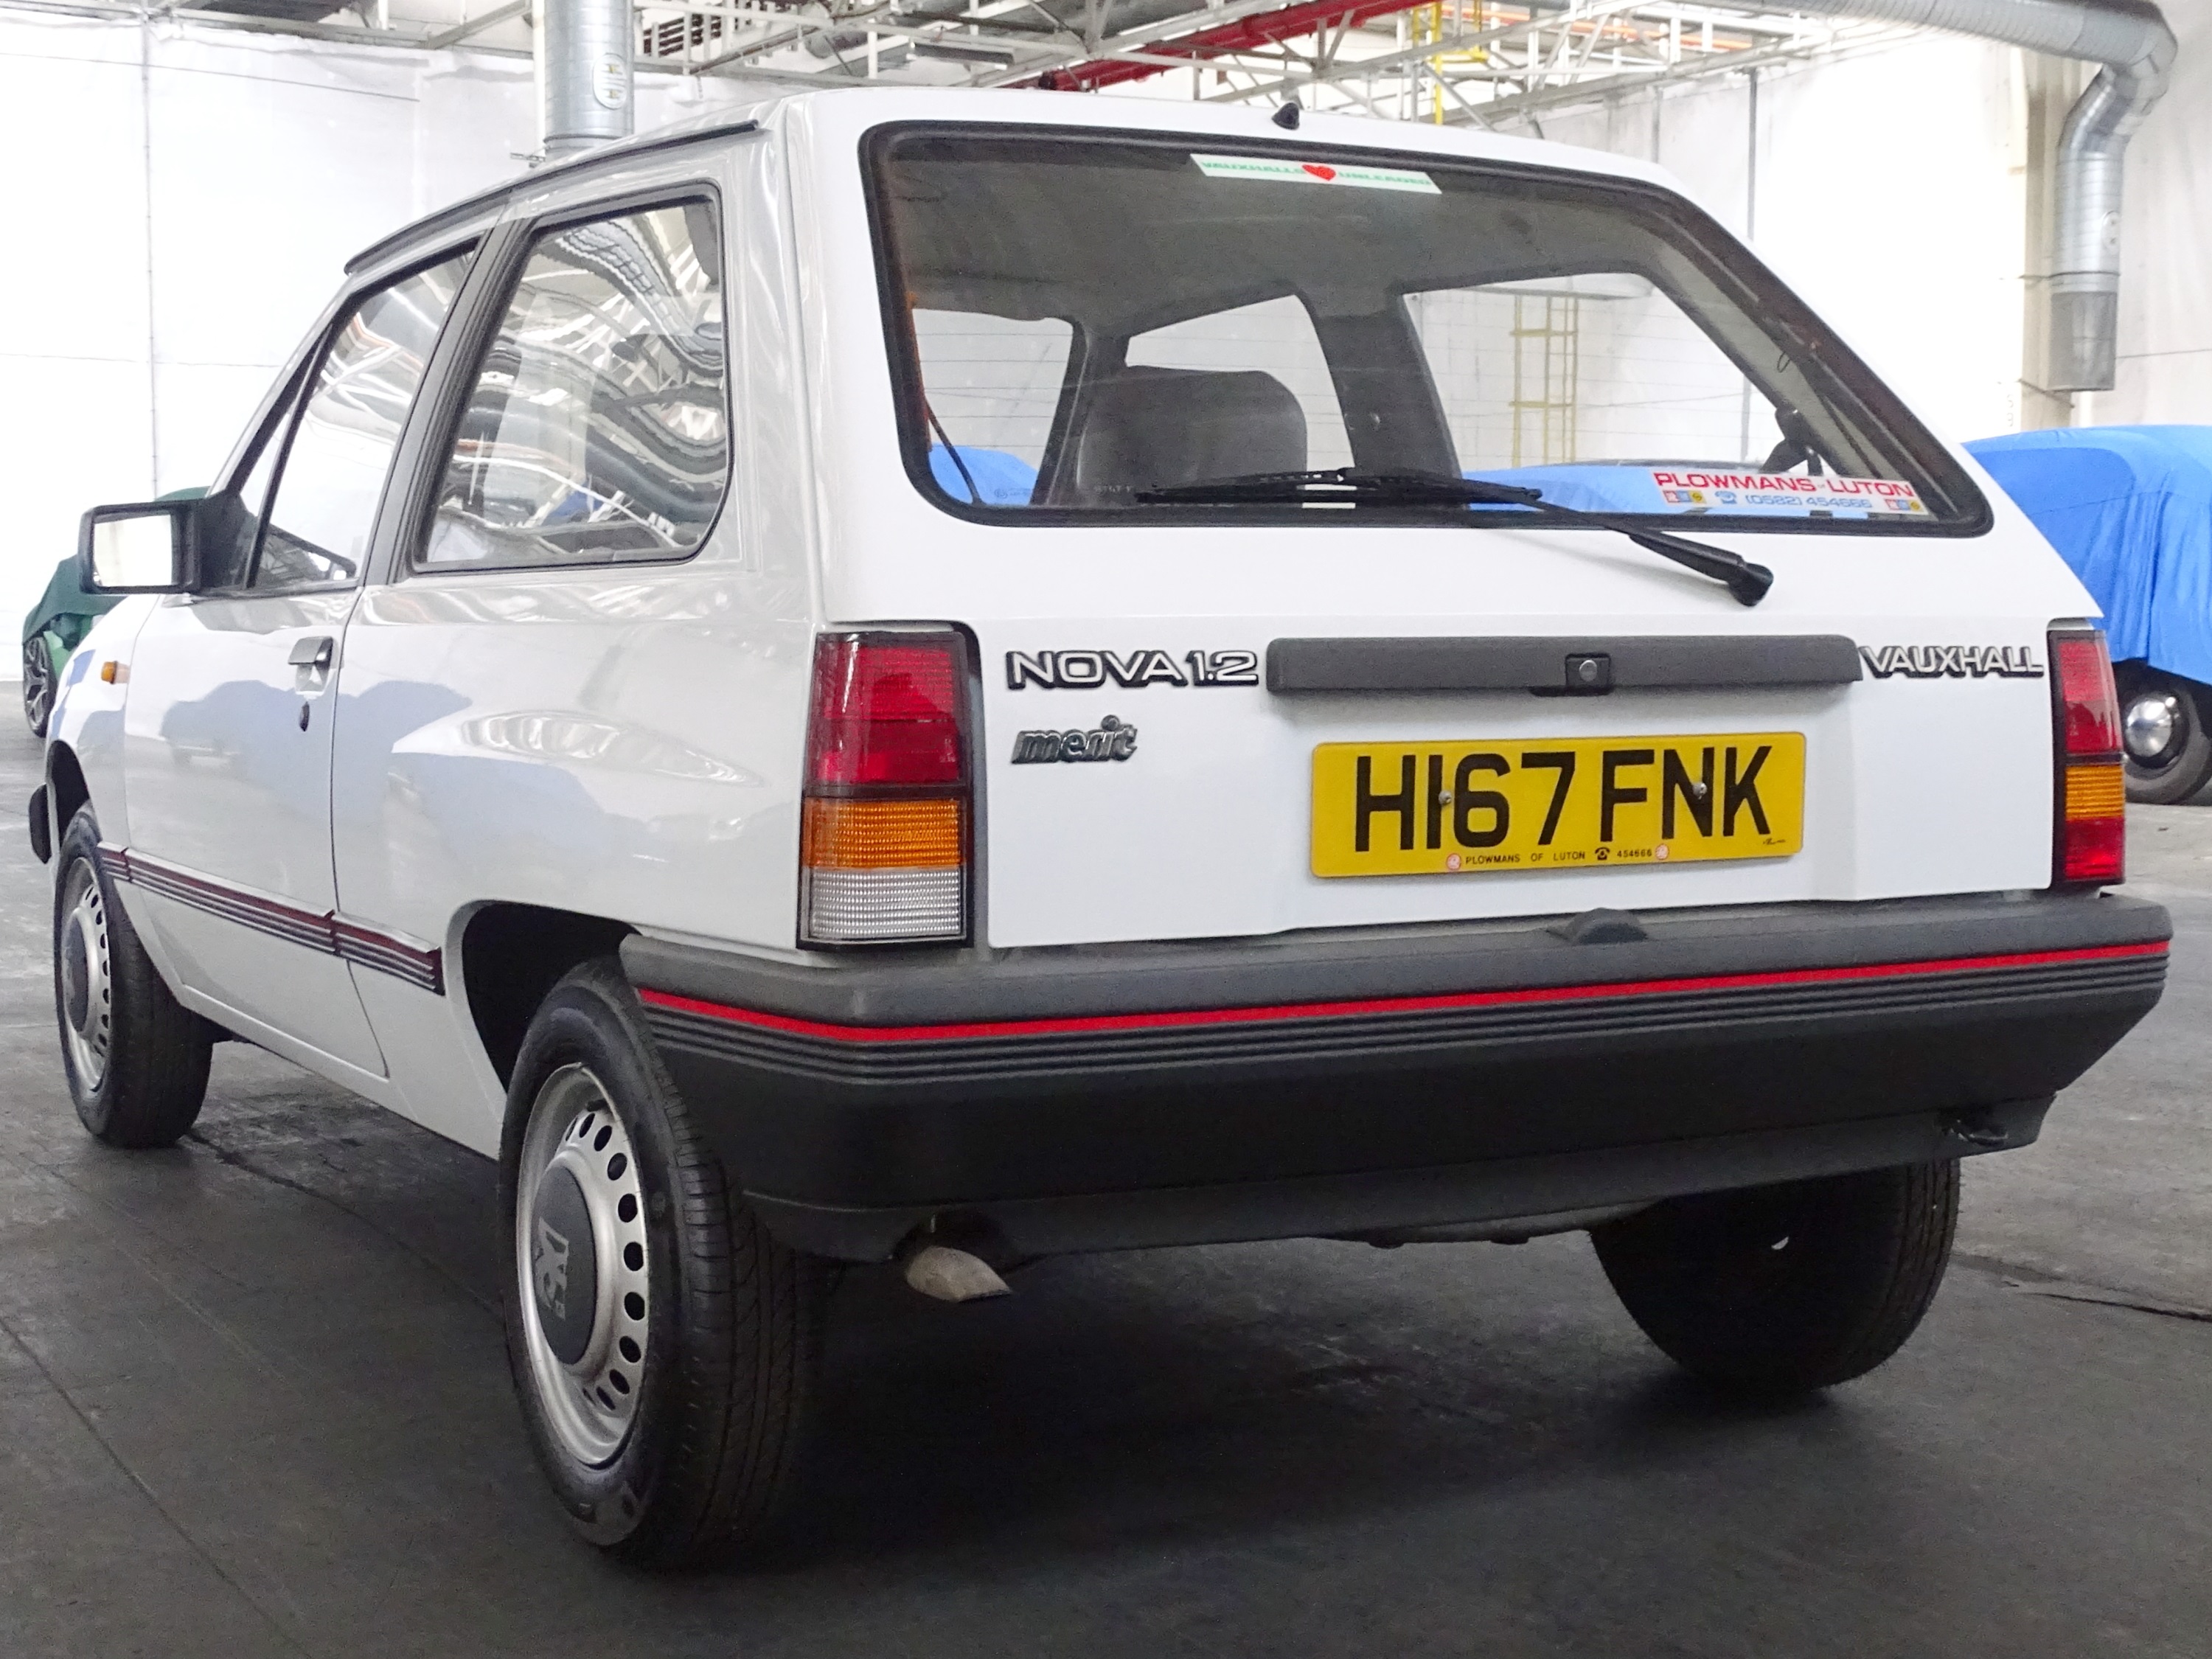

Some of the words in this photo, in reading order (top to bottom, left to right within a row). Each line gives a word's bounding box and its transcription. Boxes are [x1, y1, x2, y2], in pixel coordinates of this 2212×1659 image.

[1654, 473, 1816, 492] PLOWMANS
[1829, 481, 1914, 497] LUTON
[1006, 650, 1189, 690] NOVA
[1857, 645, 2044, 679] VAUXHALL
[1011, 714, 1138, 765] merit
[1599, 745, 1772, 843] FNK
[1465, 854, 1521, 866] PLOWMANS
[1530, 852, 1544, 862] OF
[1553, 851, 1585, 862] LUTON
